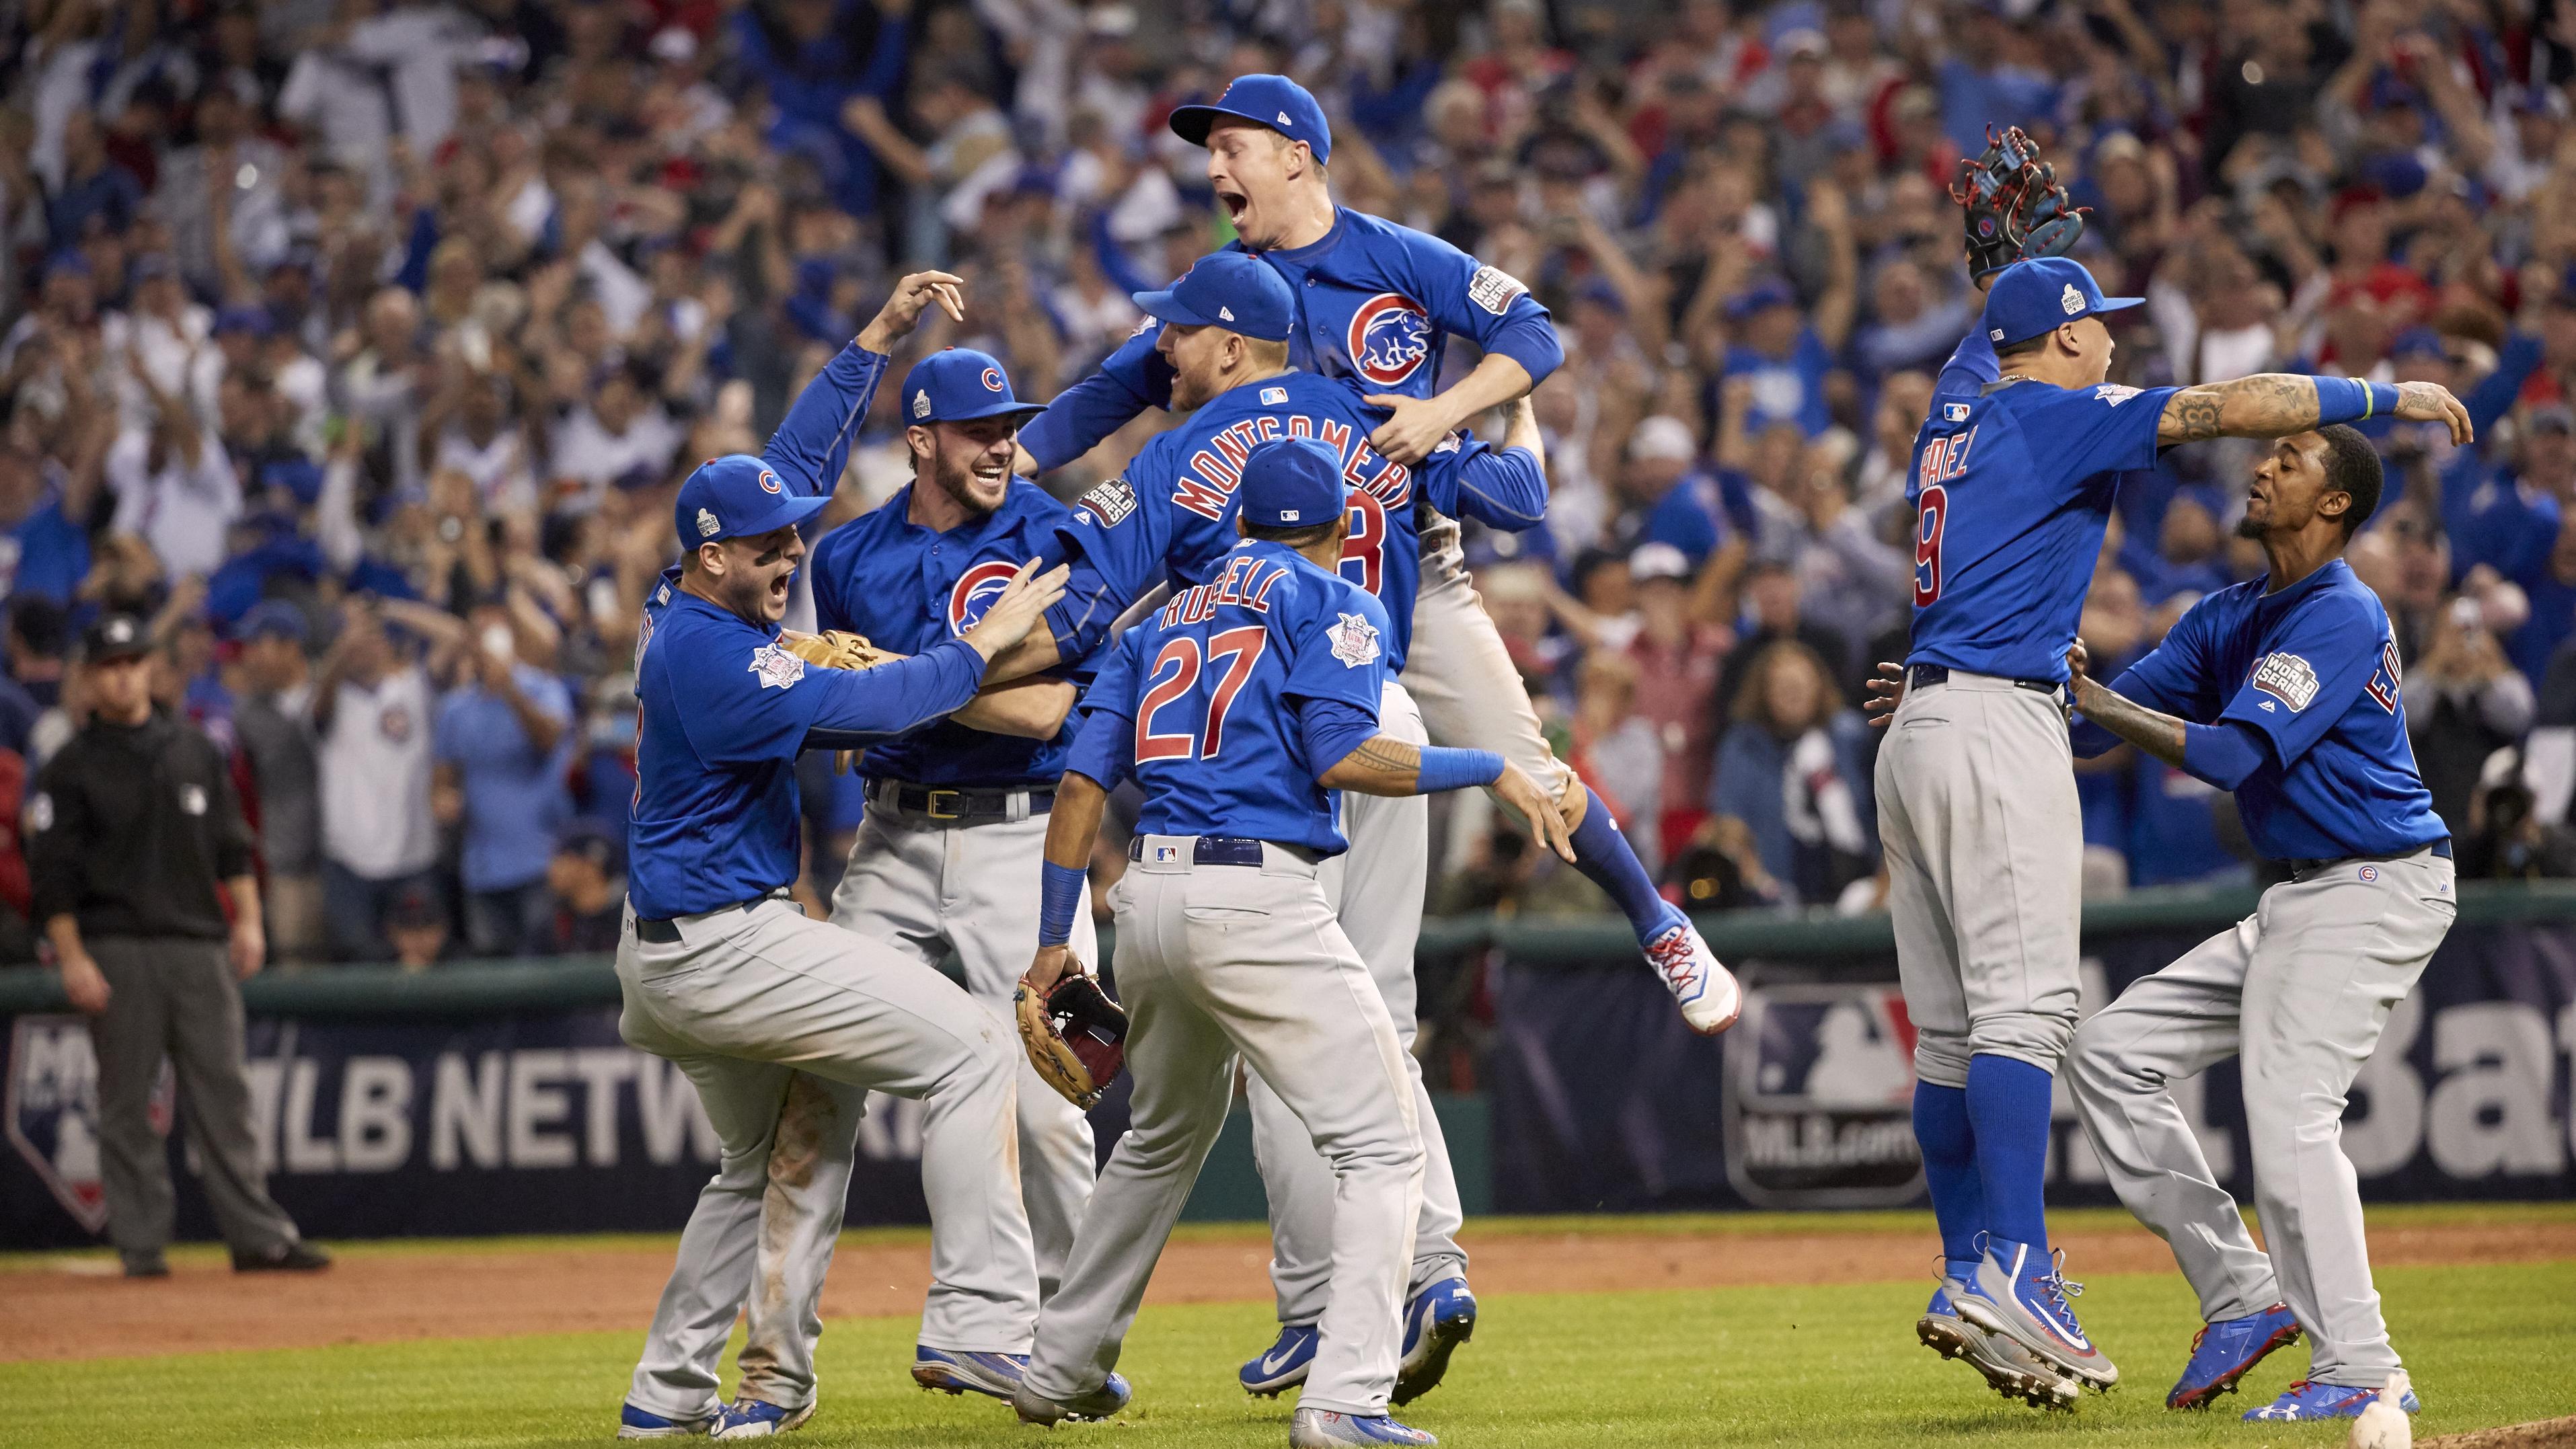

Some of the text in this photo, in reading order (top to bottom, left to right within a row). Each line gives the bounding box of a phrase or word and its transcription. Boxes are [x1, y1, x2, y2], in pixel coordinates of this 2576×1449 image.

[2063, 292, 2082, 305] WORLD
[2065, 298, 2084, 311] SERIES
[981, 367, 1003, 392] C
[914, 399, 929, 407] WORLD
[915, 405, 930, 415] SERIES
[759, 470, 781, 494] C
[1097, 482, 1133, 511] WORLD
[1084, 489, 1123, 522] SERIES
[698, 516, 716, 527] WORLD
[699, 522, 718, 533] SERIES
[1914, 484, 1948, 608] 9
[1159, 557, 1289, 632] RUSELL
[2258, 668, 2308, 707] SERIES
[2267, 656, 2316, 694] WORLD
[1135, 625, 1268, 766] 27
[2337, 982, 2576, 1179] Ba
[429, 1046, 928, 1170] NETW
